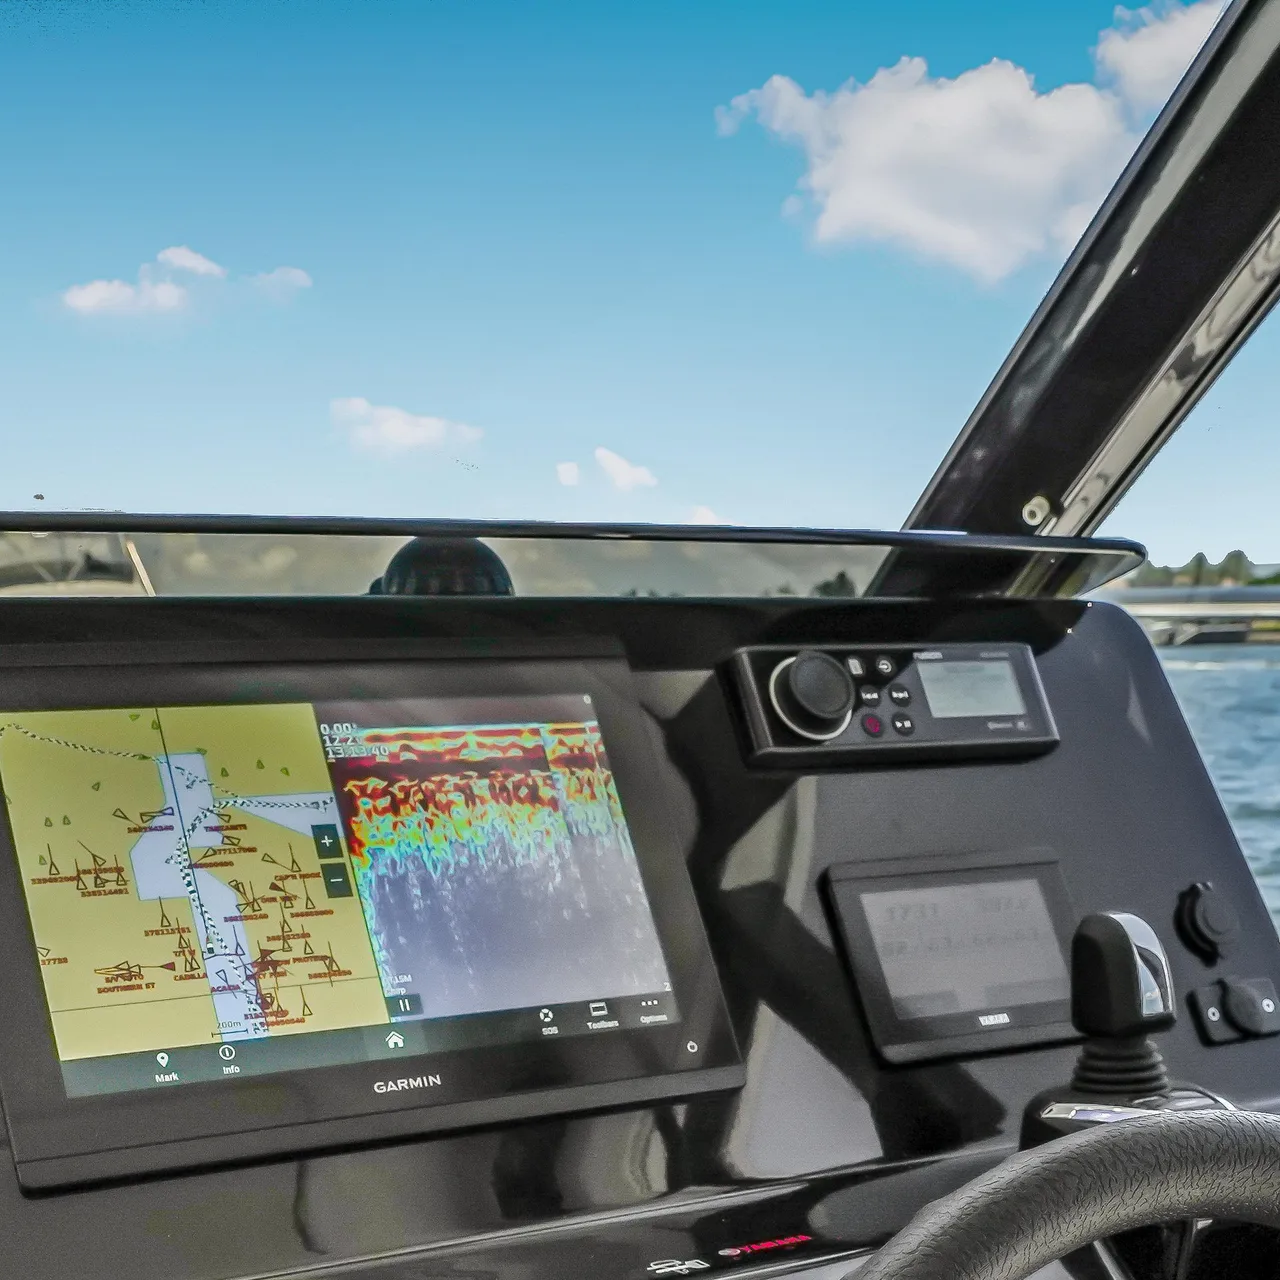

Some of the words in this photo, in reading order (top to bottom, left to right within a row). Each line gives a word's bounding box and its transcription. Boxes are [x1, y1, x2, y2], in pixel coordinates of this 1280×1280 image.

[223, 1065, 240, 1075] Info
[155, 1072, 179, 1083] Mark
[373, 1074, 441, 1094] GARMIN
